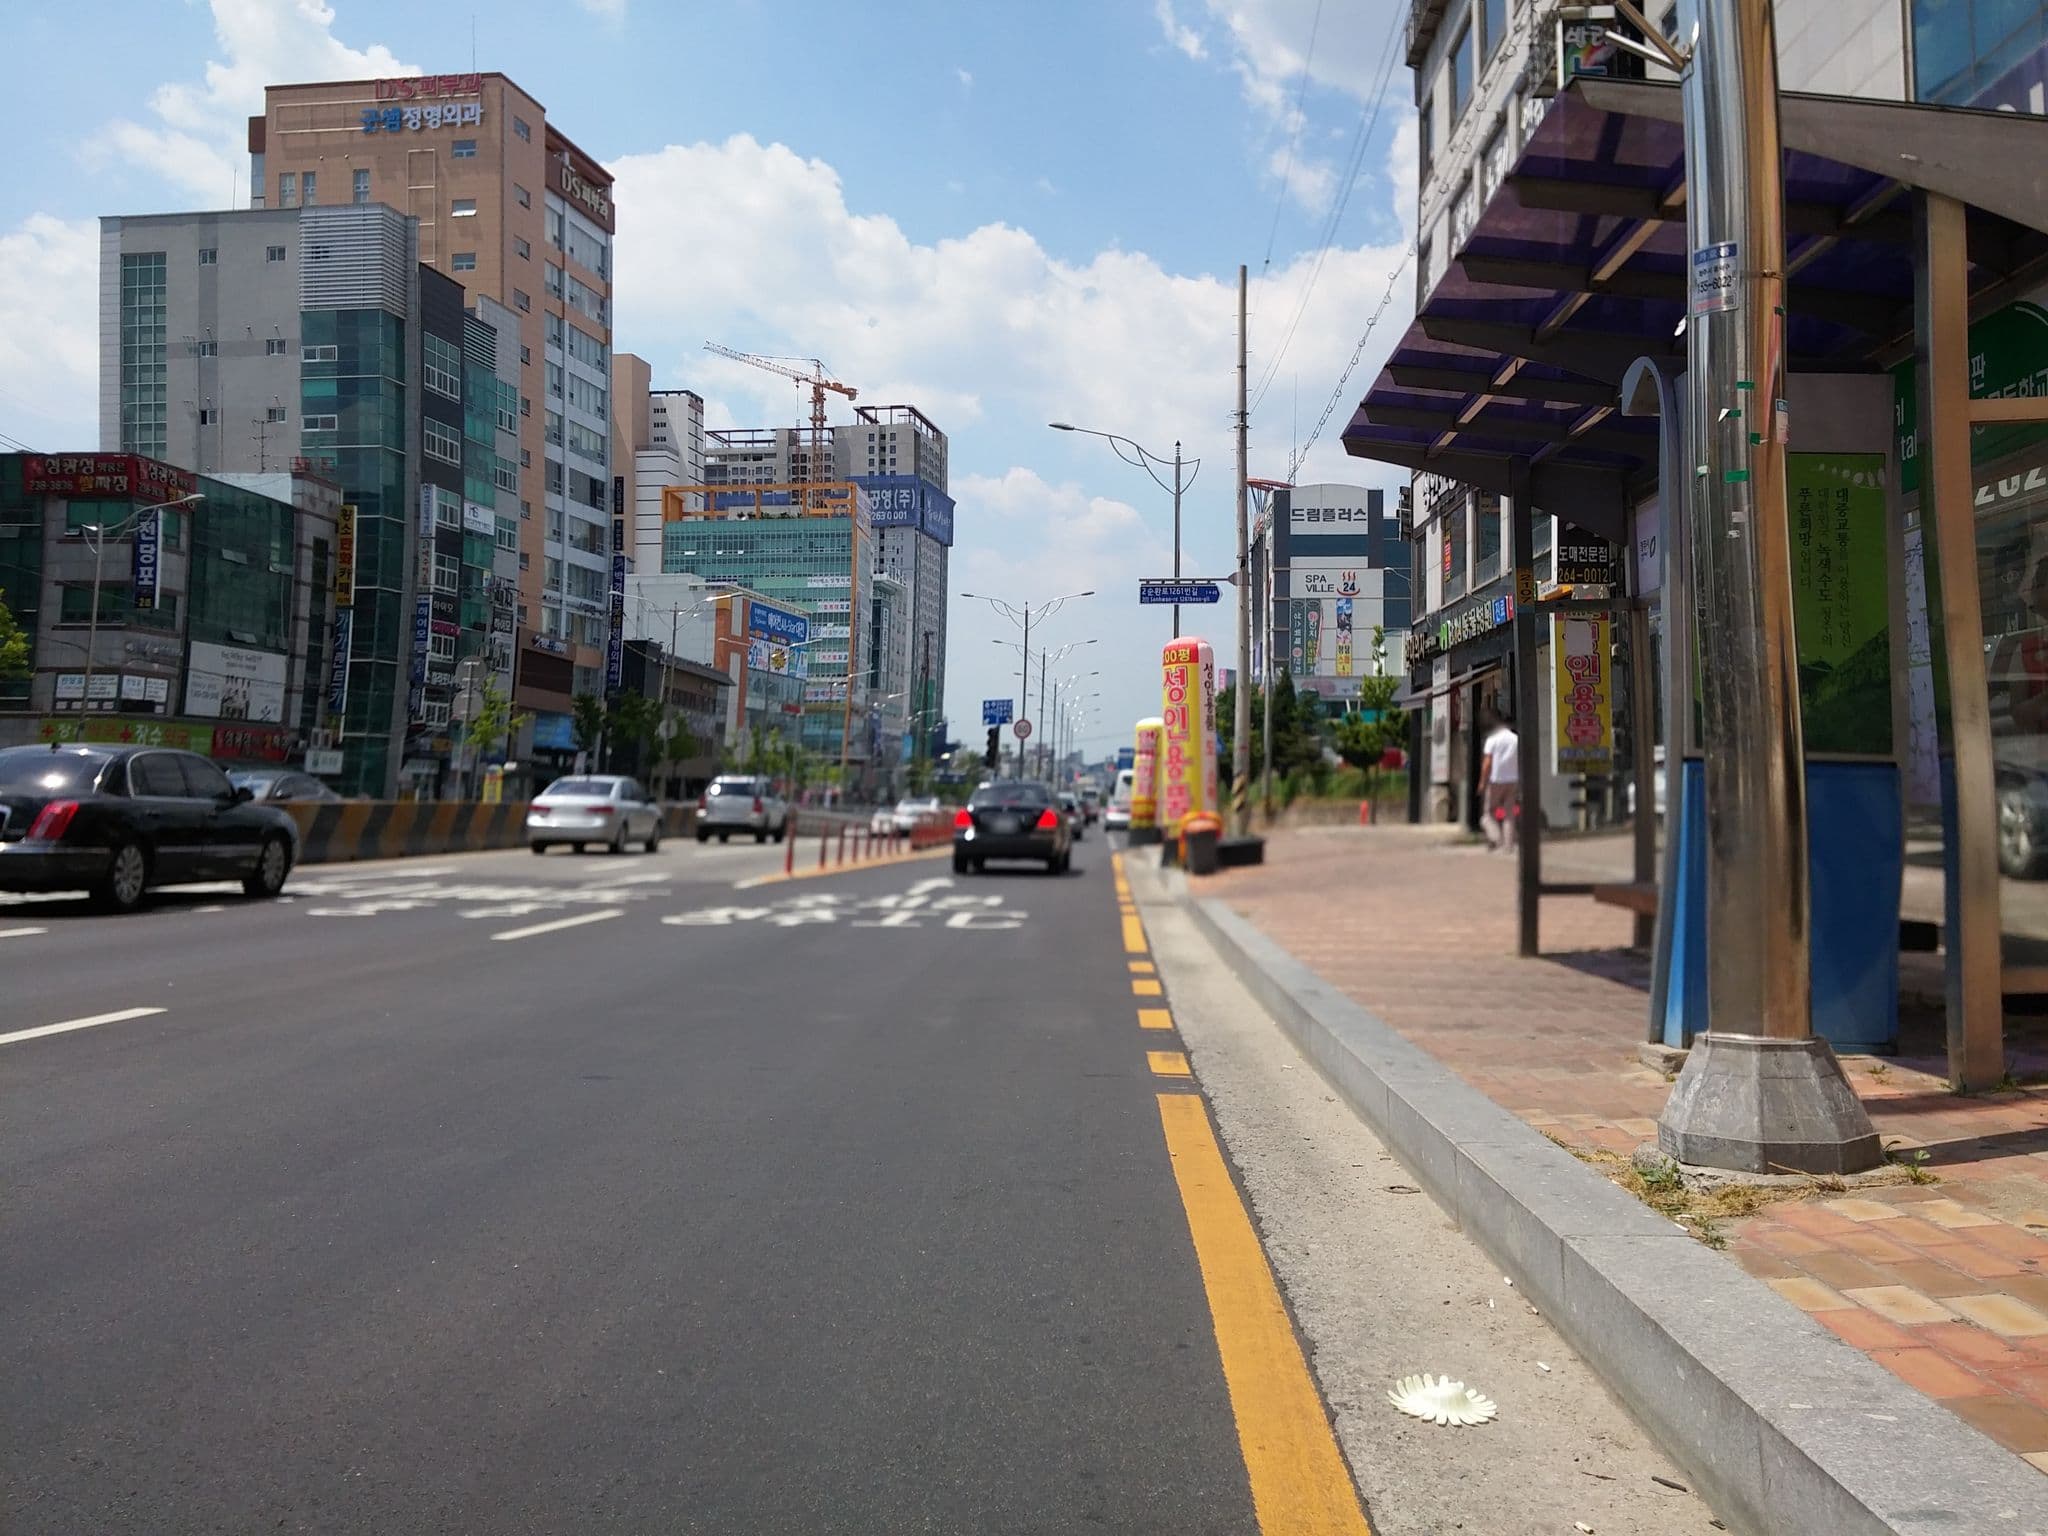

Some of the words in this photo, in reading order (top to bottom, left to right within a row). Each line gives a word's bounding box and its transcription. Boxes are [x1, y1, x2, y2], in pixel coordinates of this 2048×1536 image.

[1291, 508, 1367, 523] 드림플러스
[1559, 546, 1608, 562] 도매전문점
[1305, 574, 1327, 584] SPA
[1559, 568, 1609, 583] 264-0012
[1305, 584, 1334, 593] VILLE
[1343, 582, 1356, 592] 24
[1563, 621, 1605, 747] 인용품
